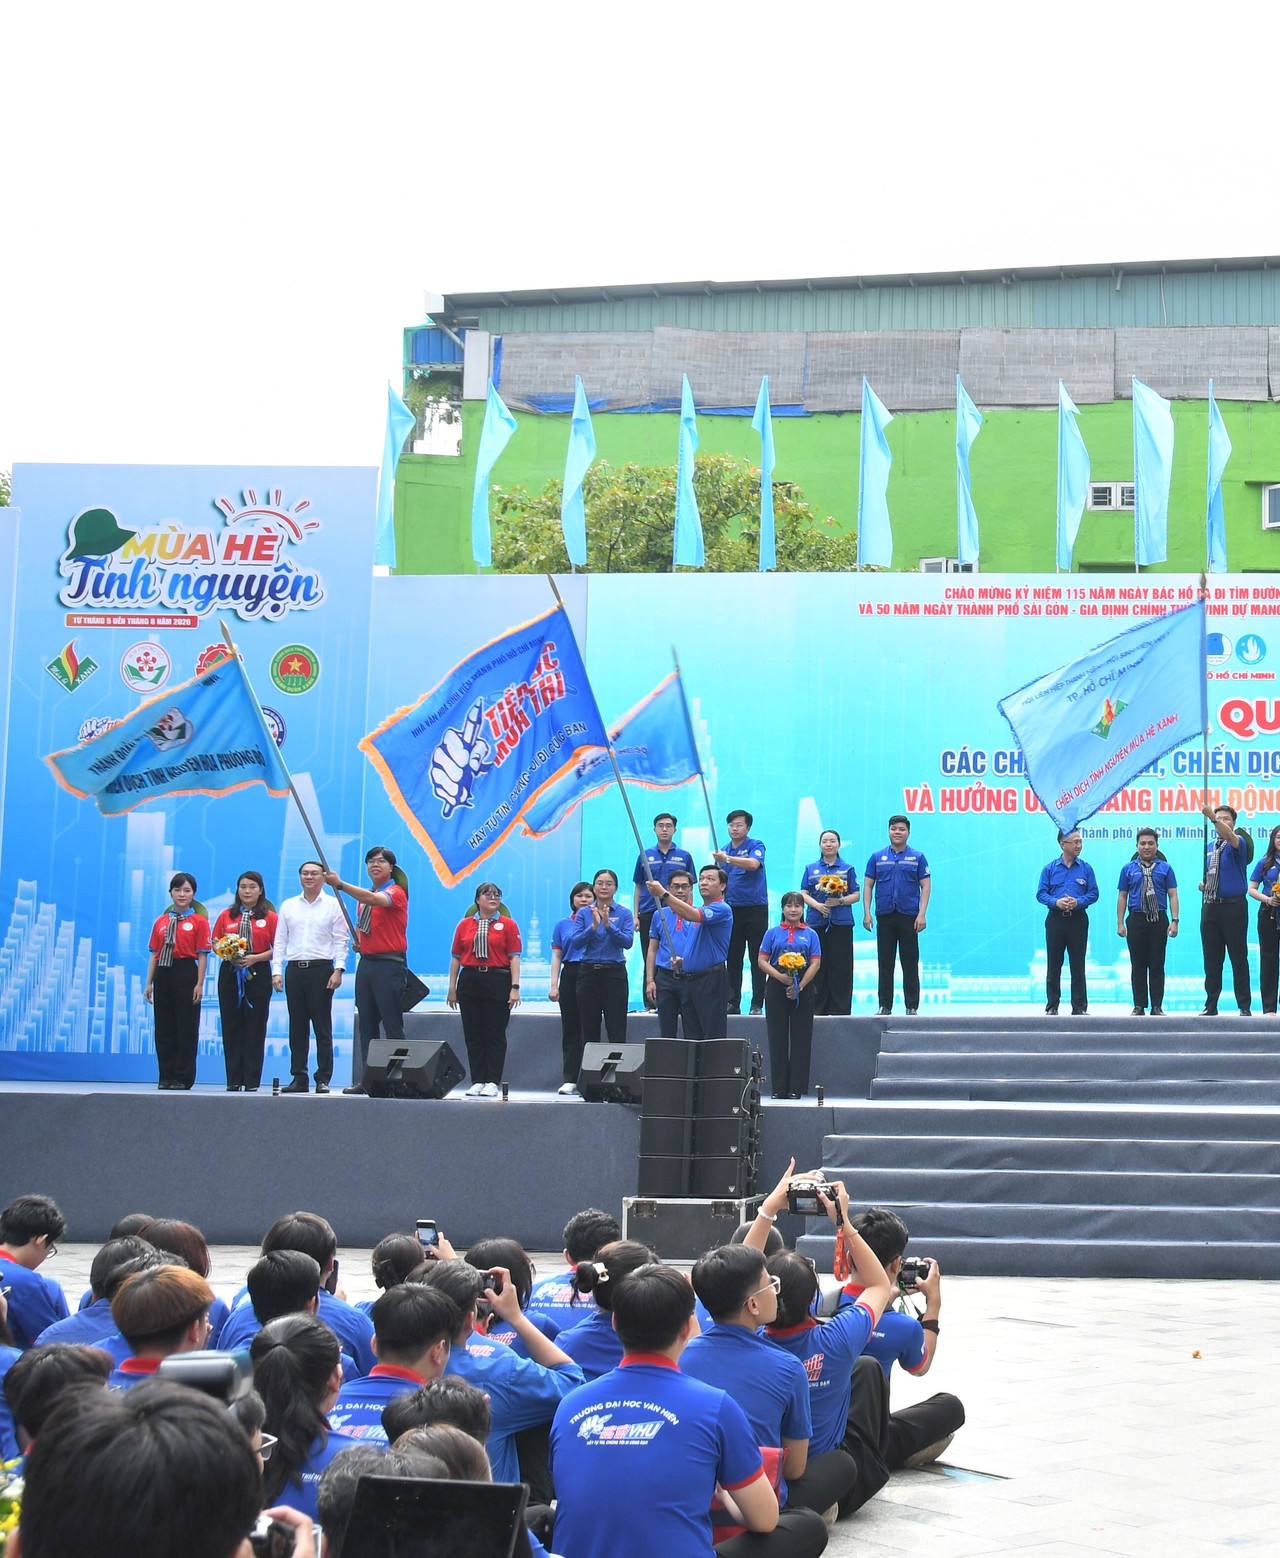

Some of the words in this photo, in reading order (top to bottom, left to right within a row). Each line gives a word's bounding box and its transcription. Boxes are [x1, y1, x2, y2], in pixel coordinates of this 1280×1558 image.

[121, 525, 211, 561] MÙA
[222, 526, 279, 561] HÈ
[67, 555, 158, 600] Tình
[168, 562, 319, 613] nguyện
[945, 587, 974, 600] CHÀO
[978, 586, 1012, 600] MỪNG
[1015, 586, 1030, 600] KỶ
[1033, 587, 1062, 601] NIỆM
[1066, 587, 1086, 600] 115
[1089, 587, 1115, 600] NĂM
[1119, 587, 1148, 600] NGÀY
[1152, 587, 1175, 600] BÁC
[1178, 586, 1194, 600] HỒ
[1214, 587, 1226, 600] ĐI
[1229, 587, 1249, 600] TÌM
[859, 602, 873, 615] VÀ
[877, 603, 891, 616] 50
[893, 602, 920, 615] NĂM
[923, 602, 953, 616] NGÀY
[957, 603, 994, 616] THÀNH
[997, 600, 1020, 616] PHỐ
[1023, 603, 1042, 616] SÀI
[1045, 603, 1069, 616] GÒN
[1080, 604, 1099, 616] GIA
[1101, 603, 1129, 618] ĐỊNH
[1132, 602, 1167, 616] CHÍNH
[1231, 603, 1248, 618] DỰ
[75, 664, 96, 685] XANH
[1216, 670, 1230, 680] HỒ
[1232, 670, 1249, 680] CHÍ
[1250, 672, 1276, 680] MINH
[1066, 690, 1083, 704] TP.
[1083, 678, 1097, 696] HỒ
[1098, 669, 1117, 688] CHÍ
[942, 746, 986, 775] CÁC
[904, 783, 934, 812] VÀ
[940, 782, 1018, 813] HƯỞNG
[1159, 783, 1221, 813] HÀNH
[468, 824, 488, 850] HÃY
[1112, 825, 1134, 843] phố
[1154, 826, 1173, 839] Chí
[1176, 826, 1204, 839] Minh
[345, 1402, 363, 1410] ĐẠI
[365, 1402, 387, 1411] HỌC
[605, 1400, 621, 1409] ĐẠI
[622, 1400, 642, 1409] HỌC
[643, 1401, 661, 1413] VĂN
[660, 1408, 680, 1426] HIẾN
[628, 1422, 661, 1437] VHU
